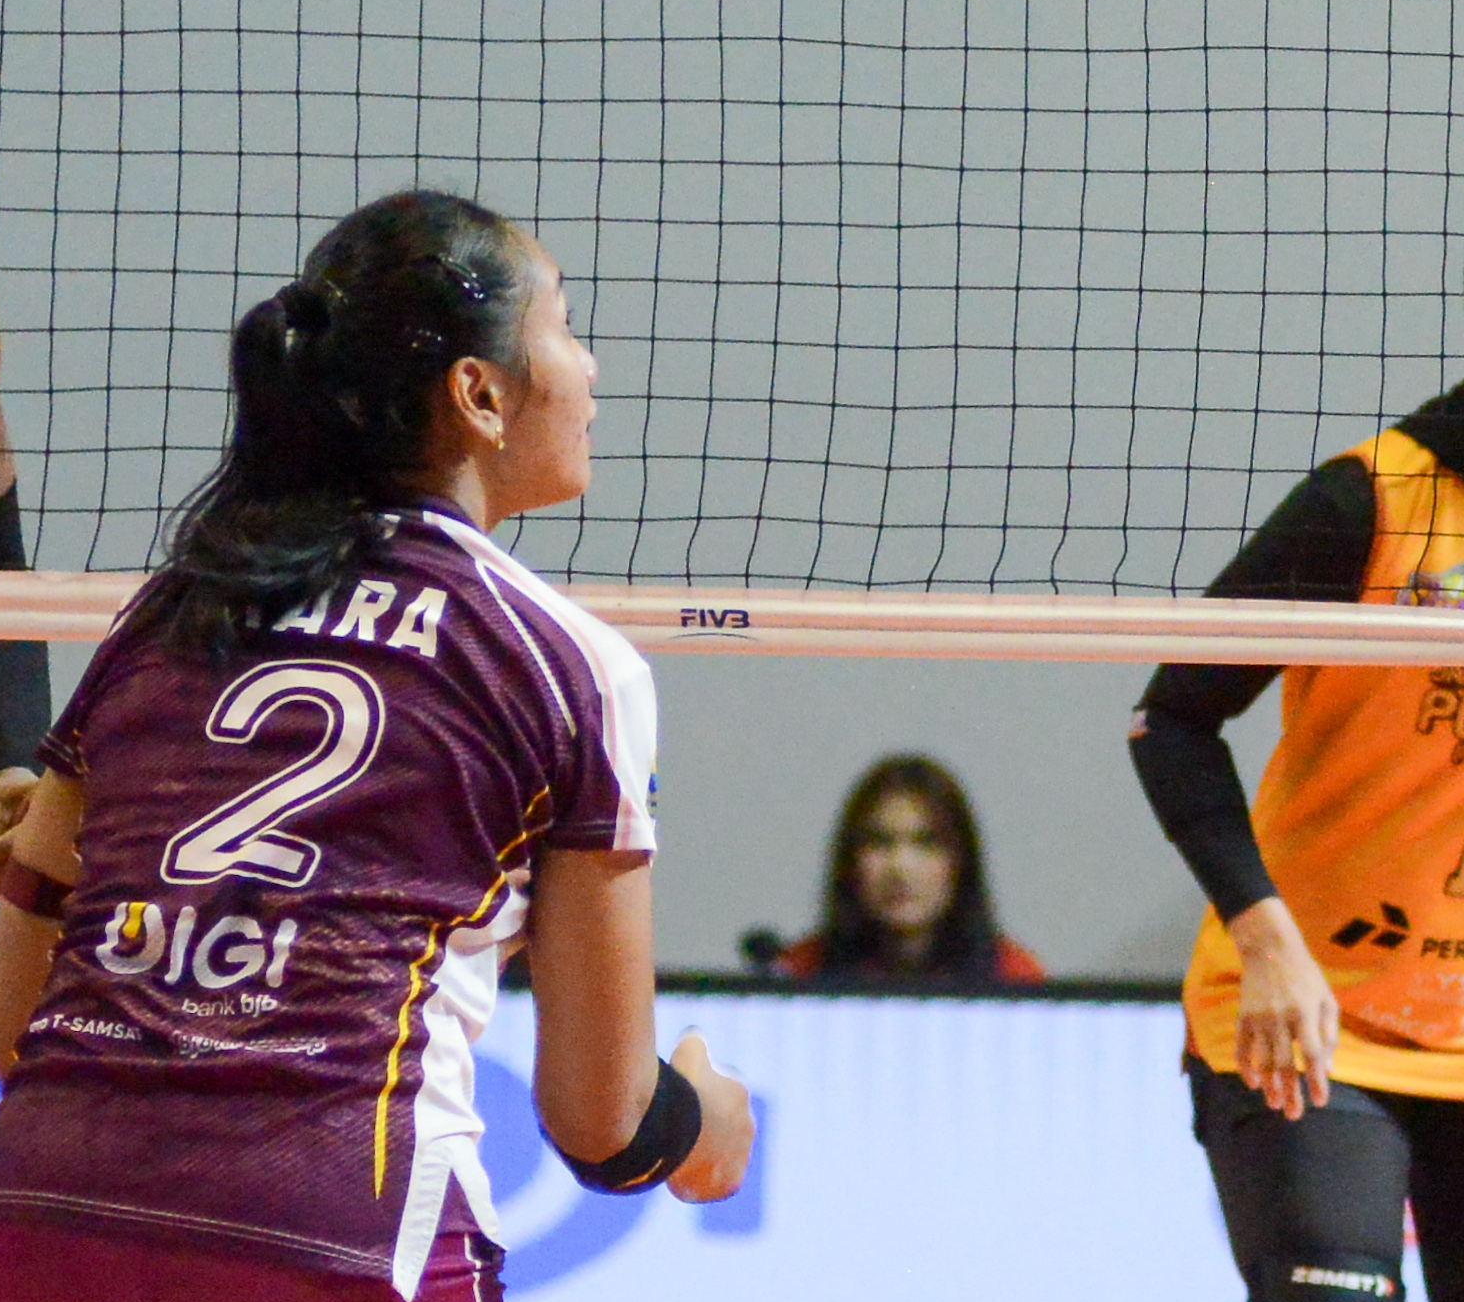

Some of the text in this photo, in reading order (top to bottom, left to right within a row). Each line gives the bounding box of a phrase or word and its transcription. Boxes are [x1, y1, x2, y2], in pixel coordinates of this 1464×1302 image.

[680, 608, 750, 629] FIVB
[160, 659, 385, 886] 2
[95, 900, 299, 990] DIGI
